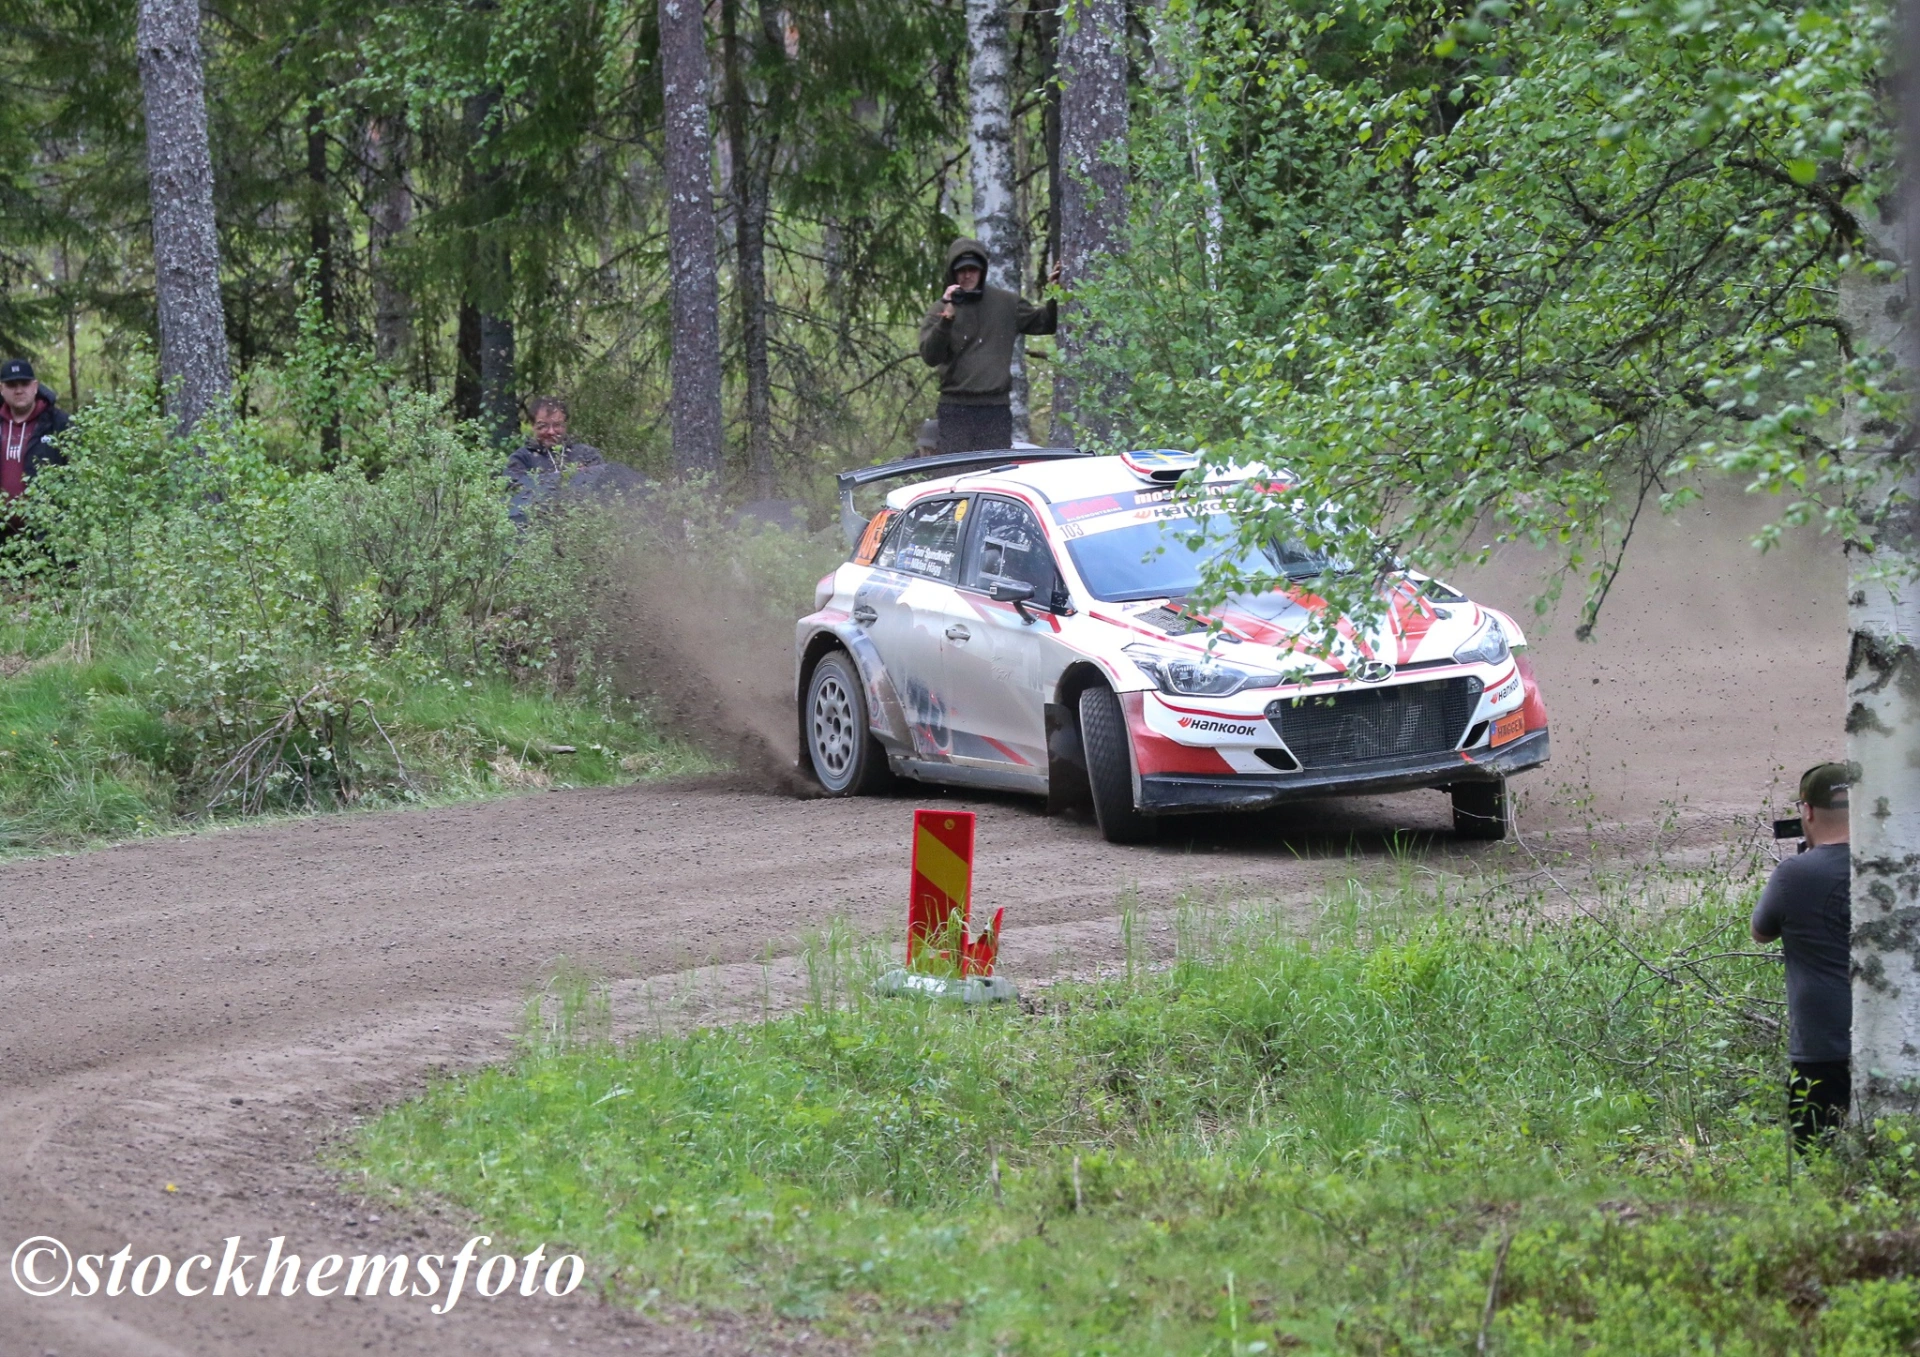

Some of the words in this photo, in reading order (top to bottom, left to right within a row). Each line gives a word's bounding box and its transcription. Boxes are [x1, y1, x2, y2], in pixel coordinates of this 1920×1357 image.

[1154, 500, 1241, 518] HANKOO
[1060, 523, 1084, 539] 103
[1190, 719, 1257, 736] HANKOOK
